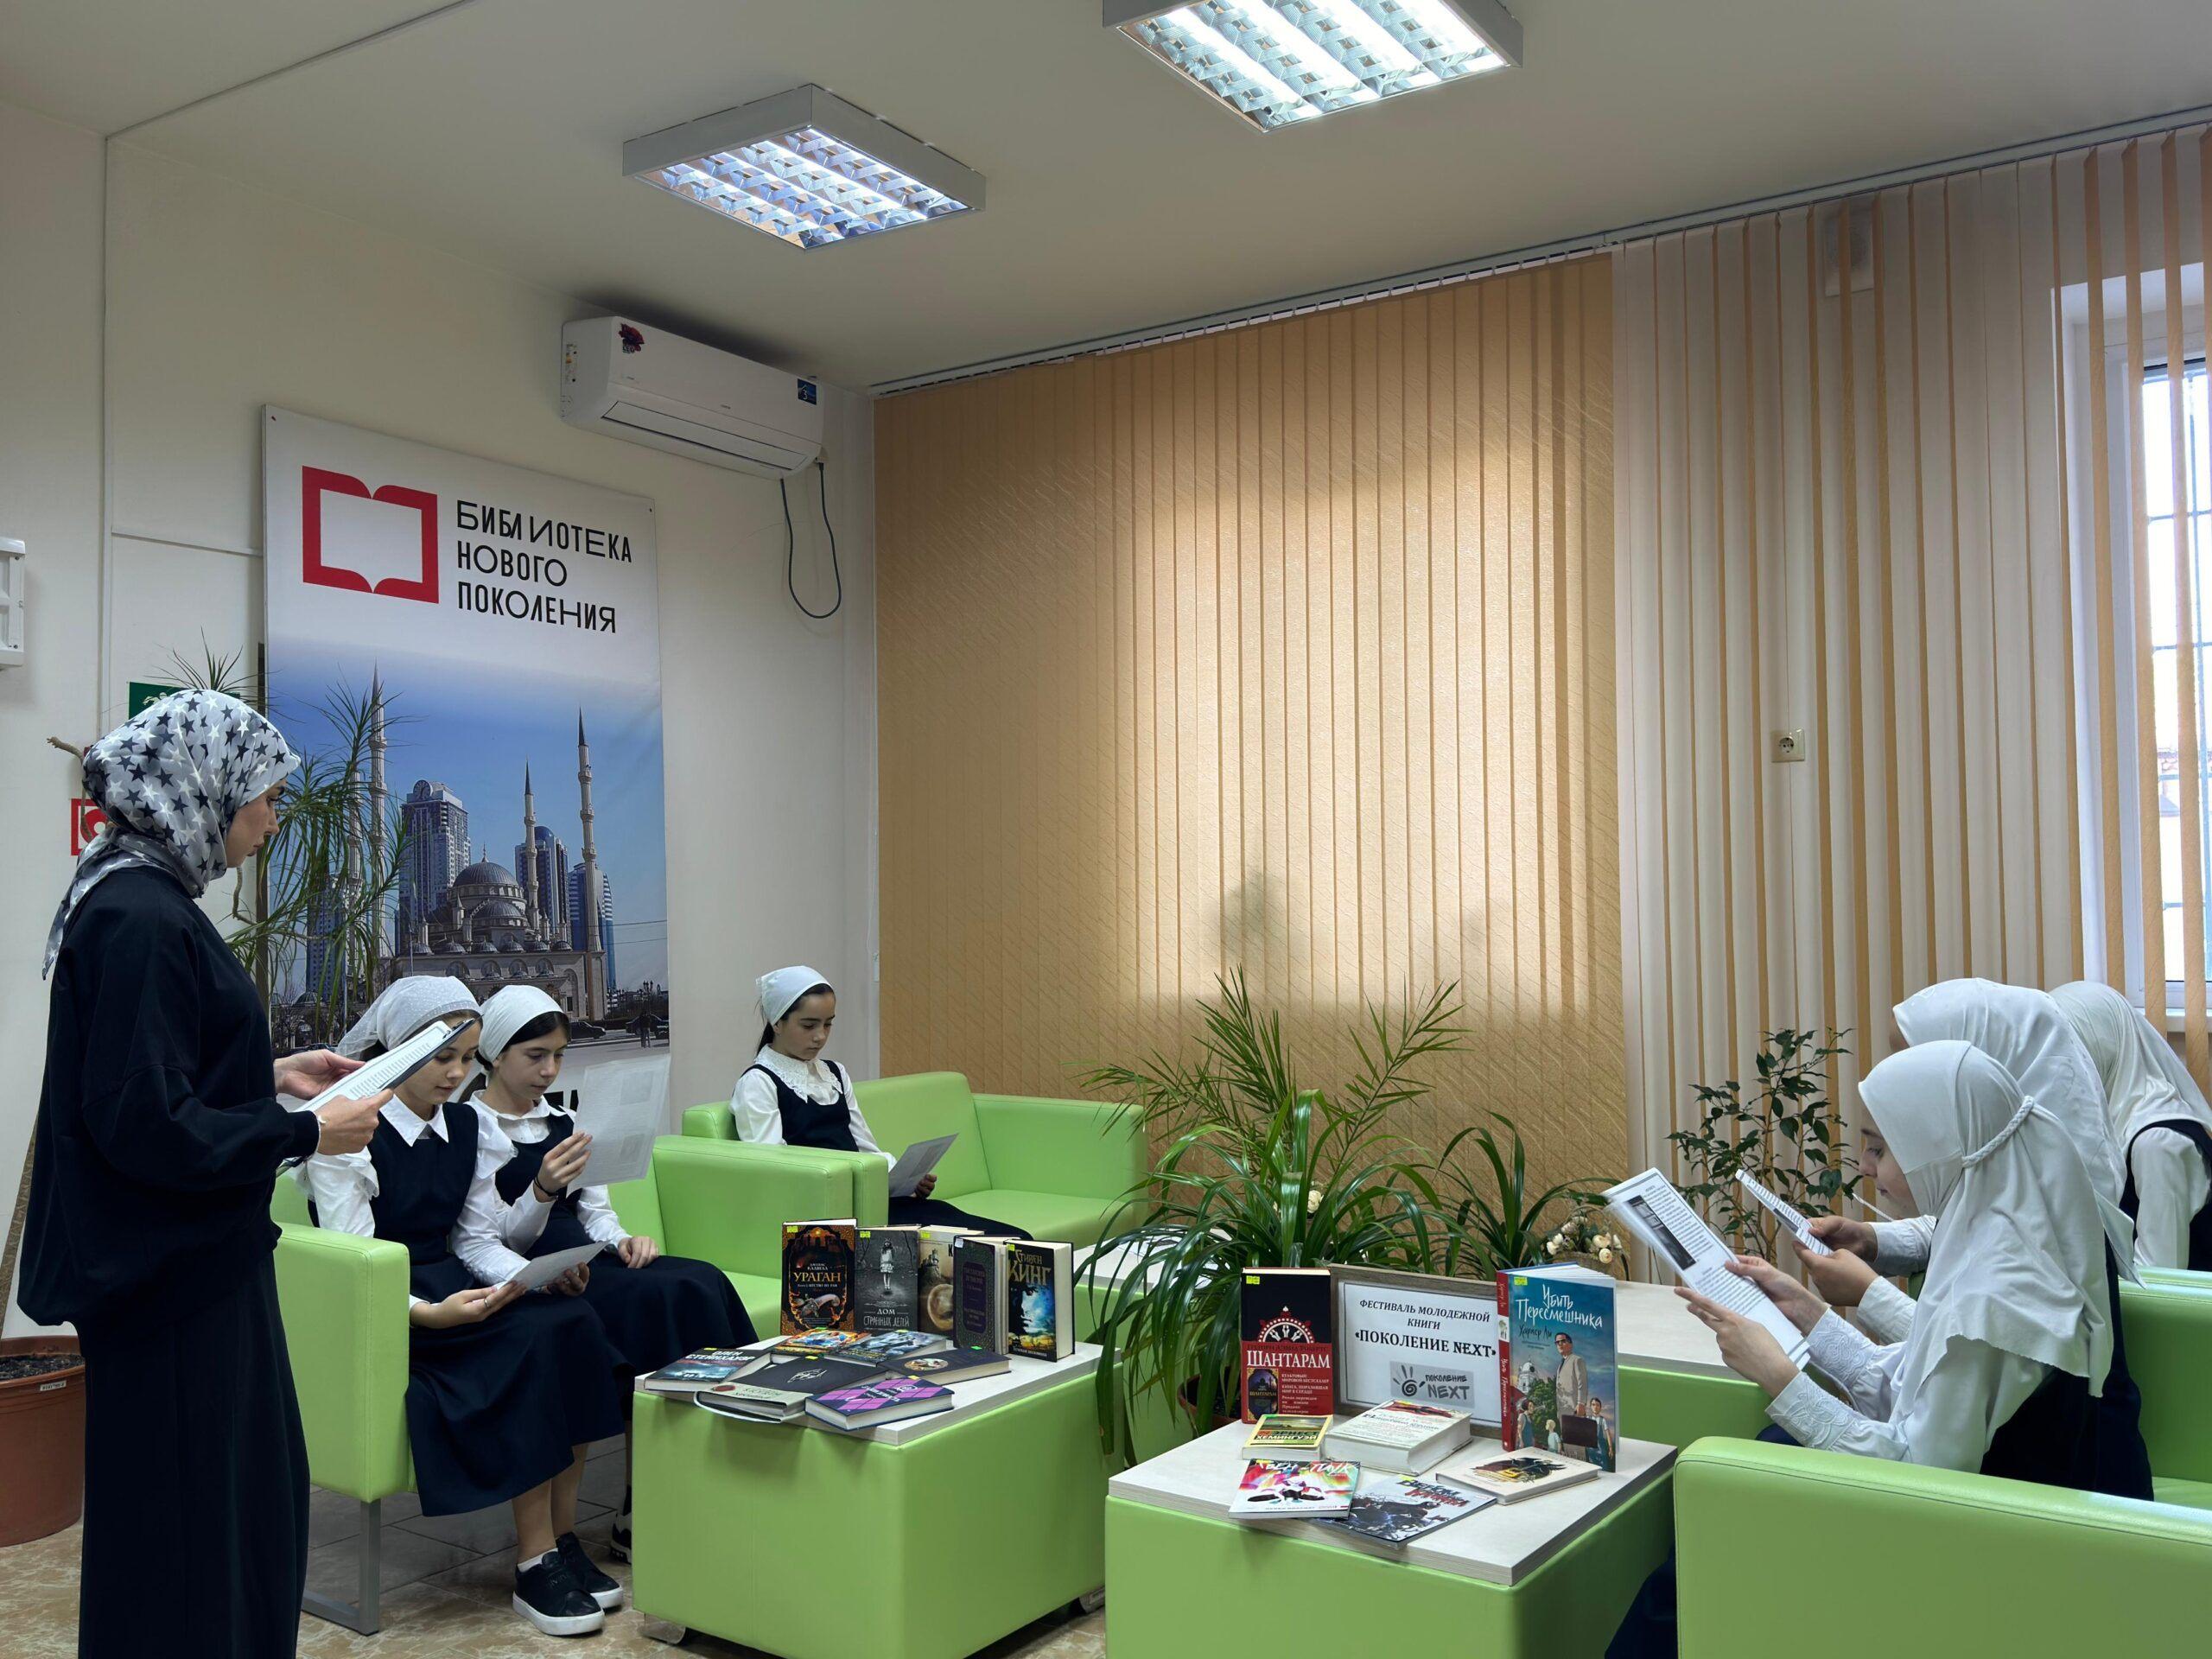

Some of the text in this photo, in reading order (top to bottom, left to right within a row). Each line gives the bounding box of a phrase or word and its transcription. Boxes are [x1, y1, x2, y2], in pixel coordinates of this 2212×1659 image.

[457, 499, 632, 563] БИБЛИОТЕКА
[457, 540, 568, 587] НОВОГО
[458, 581, 616, 633] ПОКОЛЕНИЯ
[792, 1272, 842, 1282] УРАГАН
[1009, 1260, 1052, 1286] КИНГ
[1542, 1283, 1573, 1310] Убить
[1359, 1299, 1491, 1323] ФЕСТИВАЛЬ МОЛОДЕЖНОЙ
[1407, 1318, 1440, 1330] КНИГИ
[1515, 1298, 1603, 1330] Пересмешника
[1355, 1329, 1497, 1358] «ПОКОЛЕНИЕ NEXT»
[1246, 1350, 1331, 1369] ШАНТАРАМ
[1427, 1384, 1470, 1400] NEXT
